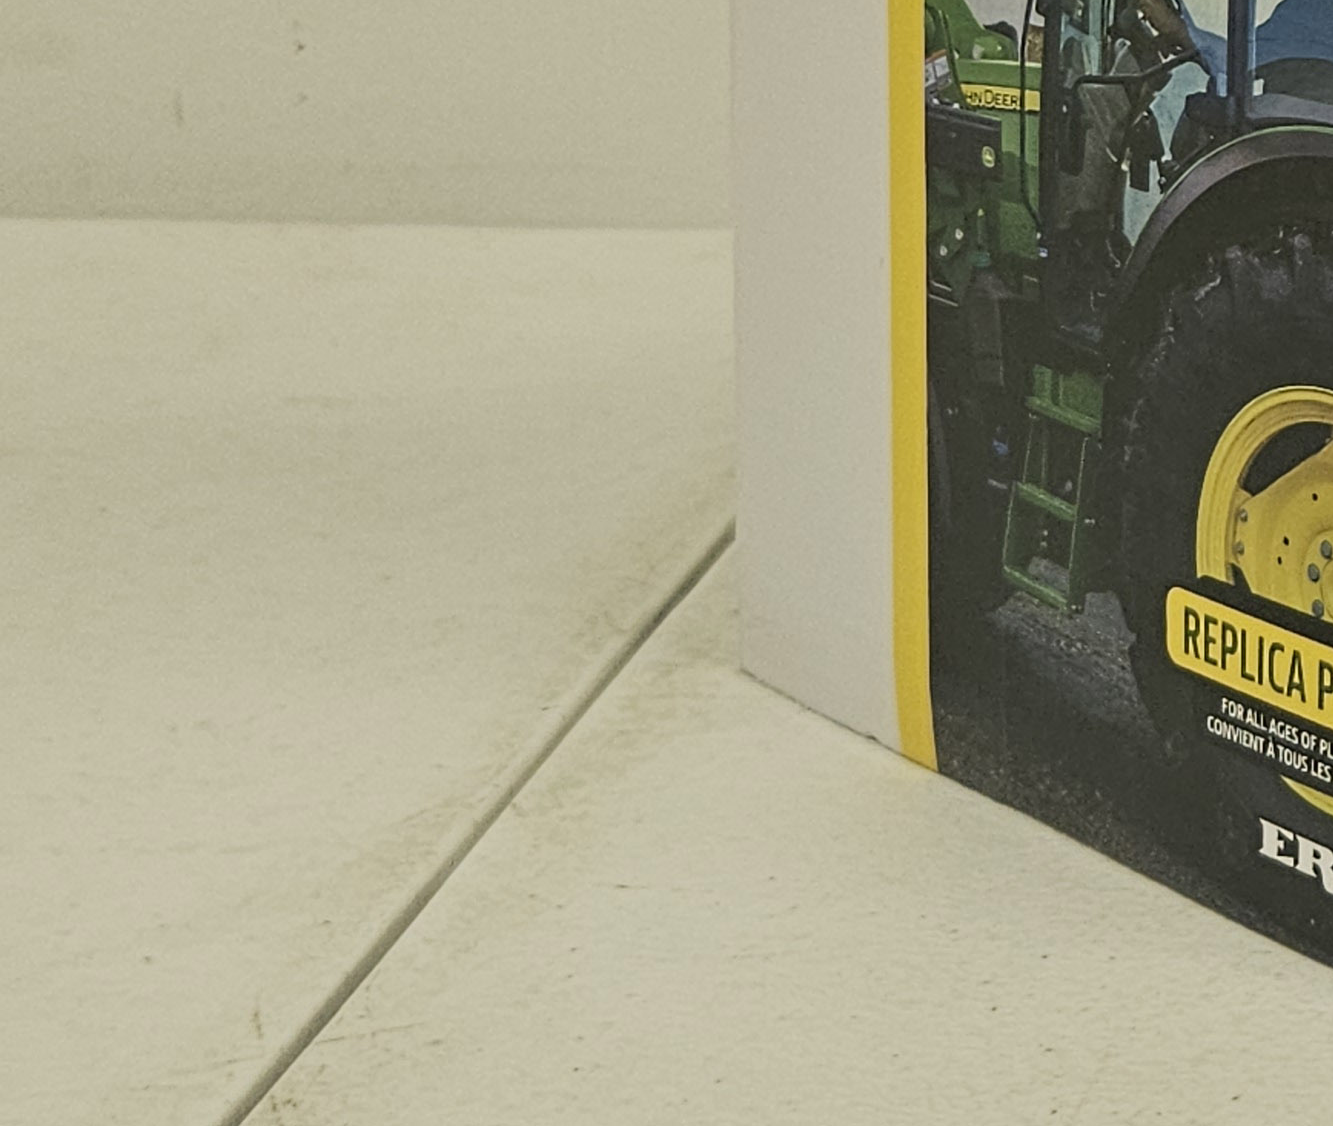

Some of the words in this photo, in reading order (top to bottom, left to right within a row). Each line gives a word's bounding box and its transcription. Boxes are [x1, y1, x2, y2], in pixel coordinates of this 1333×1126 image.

[983, 89, 1020, 107] DEER
[1183, 605, 1307, 704] REPLICA
[1206, 715, 1265, 754] CONVIENT
[1266, 735, 1276, 759] À
[1276, 744, 1309, 773] TOUS
[1310, 758, 1332, 783] LES
[1221, 697, 1244, 722] FOR
[1245, 708, 1268, 731] ALL
[1268, 718, 1299, 745] AGES
[1300, 730, 1318, 752] OF
